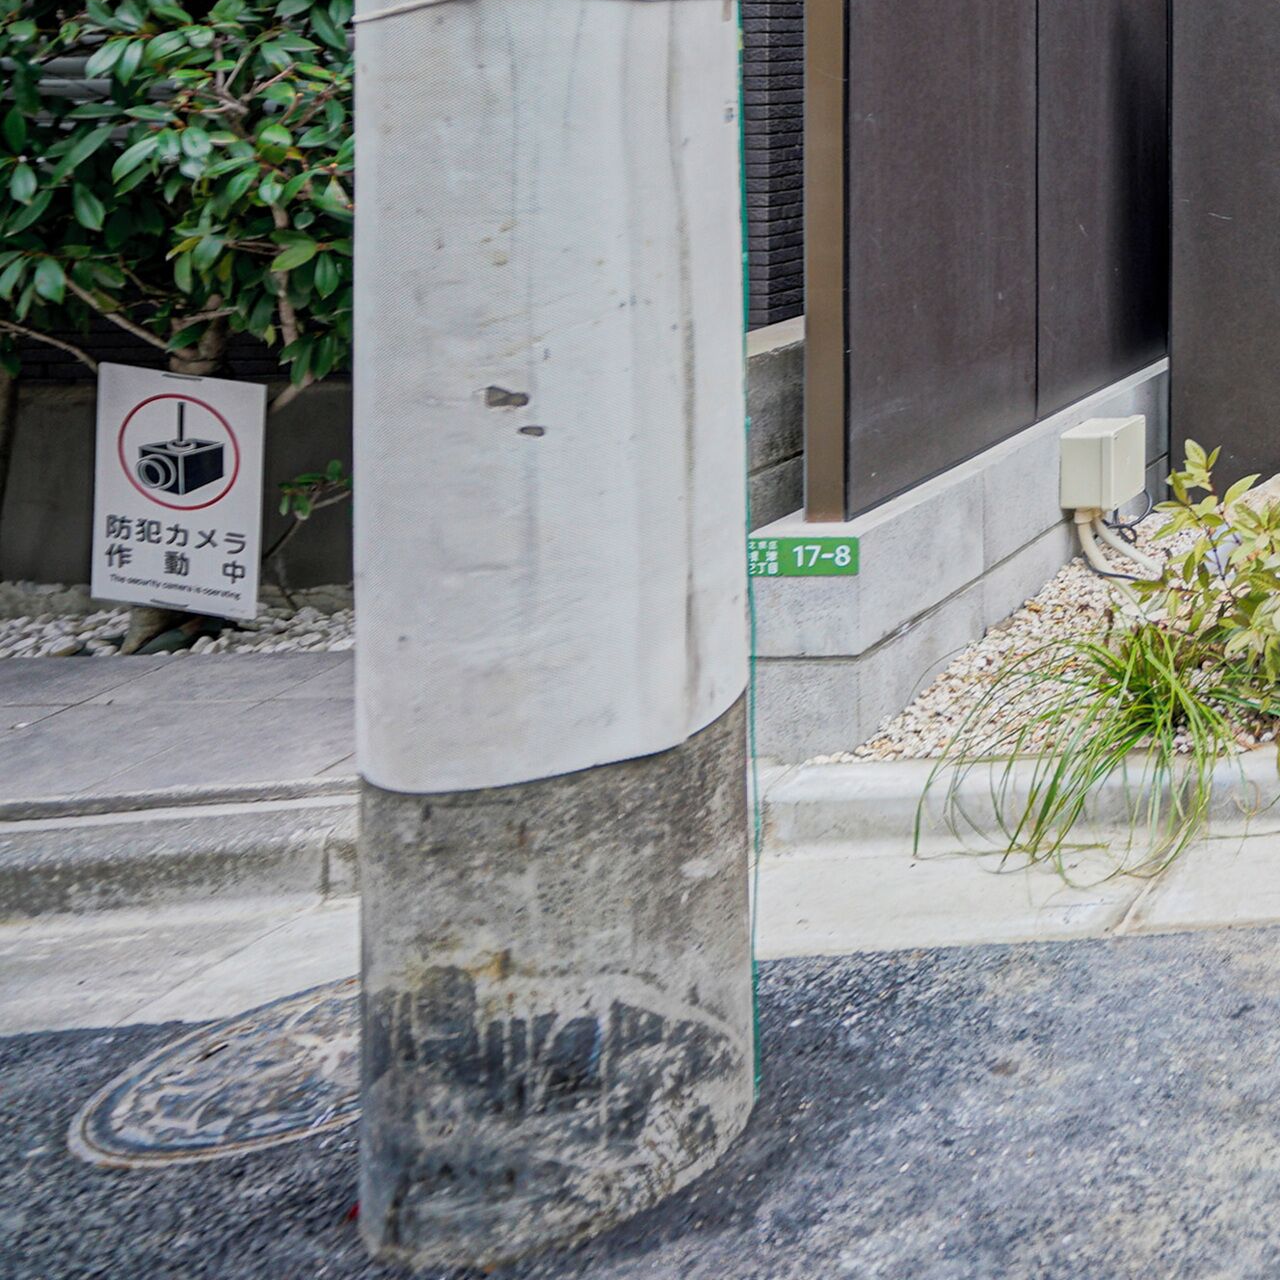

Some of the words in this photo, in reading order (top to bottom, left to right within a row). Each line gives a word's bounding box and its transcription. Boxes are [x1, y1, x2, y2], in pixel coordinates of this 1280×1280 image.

[106, 514, 246, 555] 防犯カメラ
[105, 543, 245, 584] 作動中
[792, 545, 851, 567] 17-8
